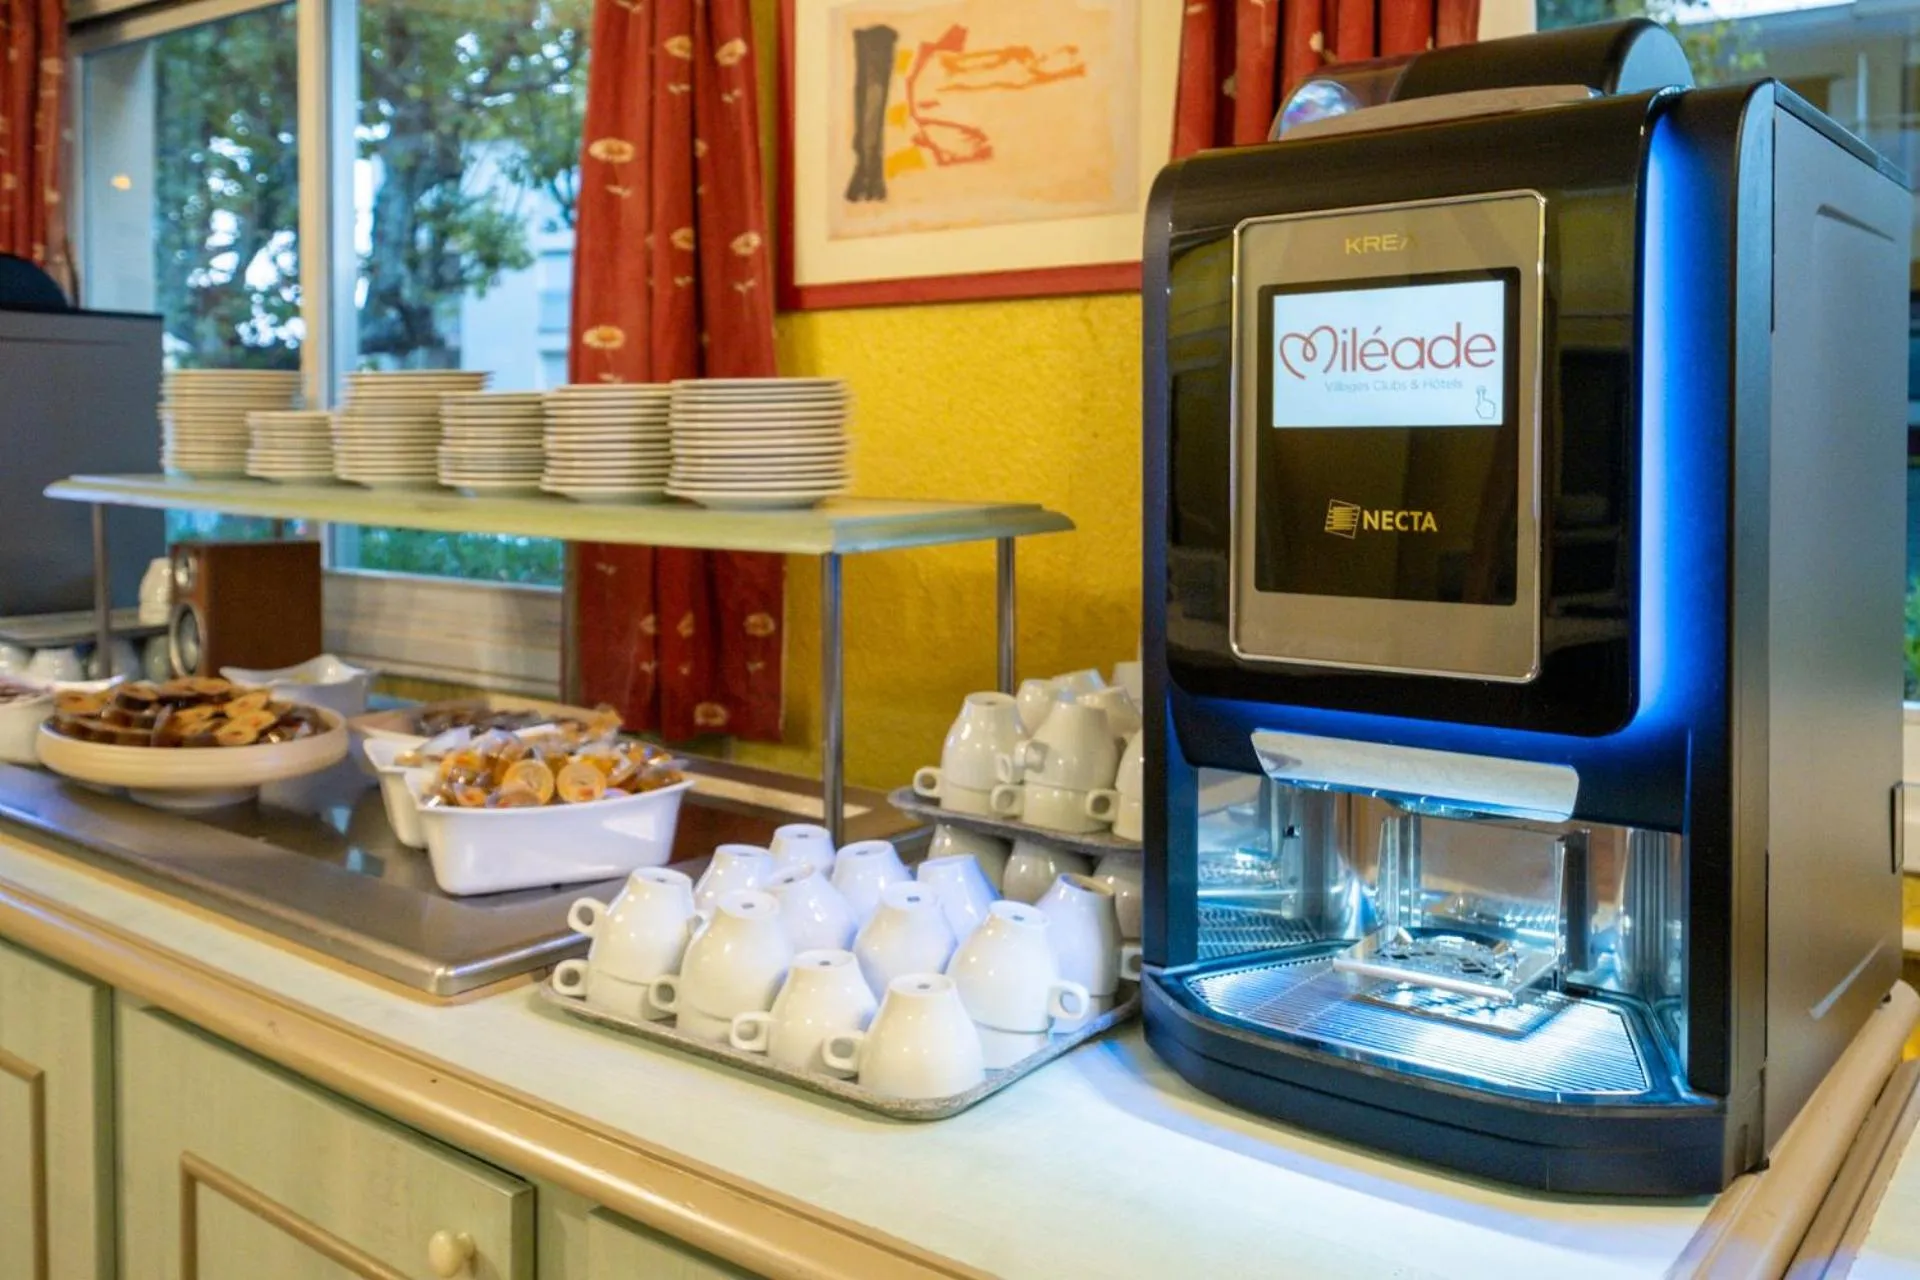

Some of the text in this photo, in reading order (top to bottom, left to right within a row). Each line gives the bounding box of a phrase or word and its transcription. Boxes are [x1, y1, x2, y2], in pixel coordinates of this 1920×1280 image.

[1279, 321, 1497, 380] Miléade
[1374, 380, 1407, 391] Clubs
[1410, 378, 1419, 390] &
[1363, 510, 1438, 532] NECTA
